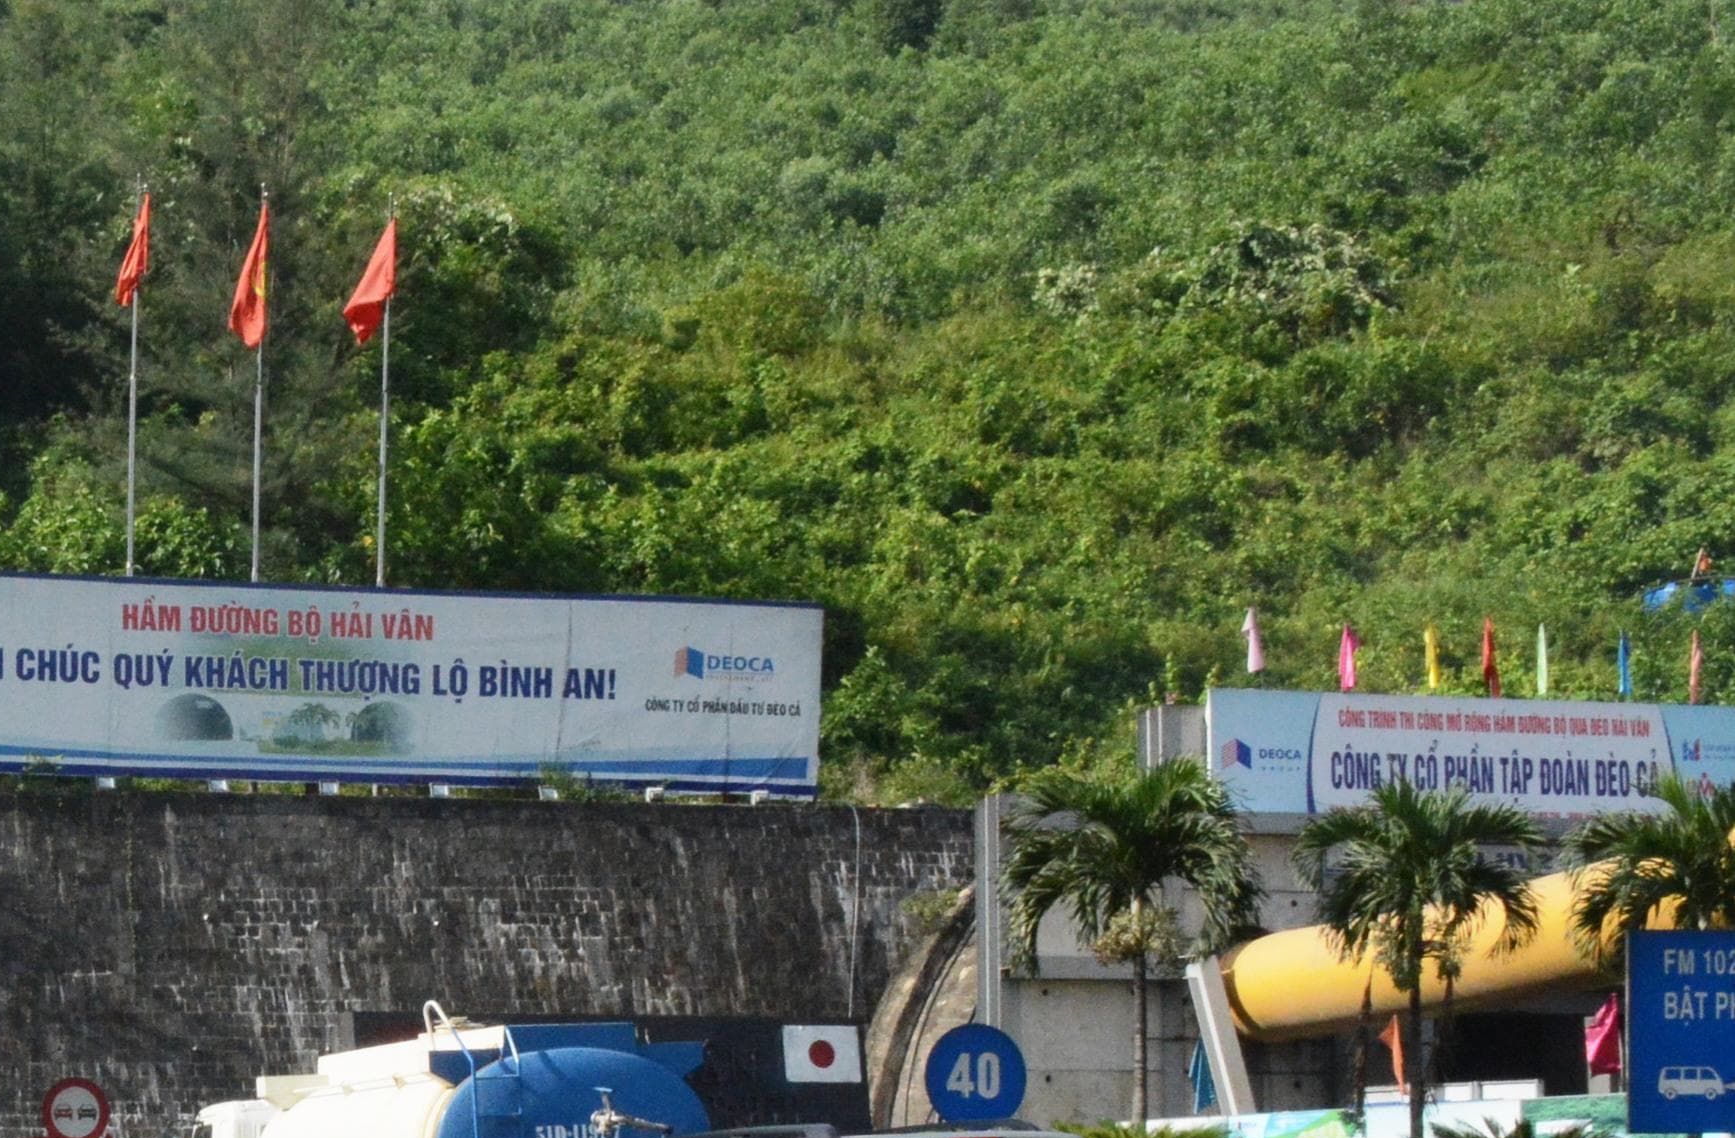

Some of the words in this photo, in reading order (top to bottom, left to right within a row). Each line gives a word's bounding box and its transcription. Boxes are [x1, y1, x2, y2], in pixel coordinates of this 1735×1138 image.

[122, 595, 181, 632] HẦM
[190, 601, 279, 635] ĐƯỜNG
[288, 605, 321, 643] BỘ
[330, 601, 372, 639] HẢI
[381, 609, 433, 640] VÂN
[15, 643, 100, 684] CHÚC
[114, 648, 174, 690] QUÝ
[185, 650, 288, 690] KHÁCH
[299, 659, 420, 701] THƯỢNG
[433, 658, 468, 703] LỘ
[479, 659, 553, 698] BÌNH
[564, 668, 616, 700] AN!
[707, 656, 774, 672] DEOCA
[645, 696, 669, 712] CÔNG
[673, 699, 684, 713] TY
[1259, 747, 1302, 760] DEOCA
[1331, 743, 1380, 790] CÔNG
[1414, 739, 1438, 791] CỔ
[1444, 742, 1494, 793] PHẦN
[1499, 749, 1533, 803] TẬP
[1539, 751, 1589, 797] ĐOÀN
[1595, 752, 1630, 798] ĐÈO
[1664, 949, 1695, 975] FM
[1665, 985, 1708, 1026] BẬT
[946, 1052, 1000, 1099] 40
